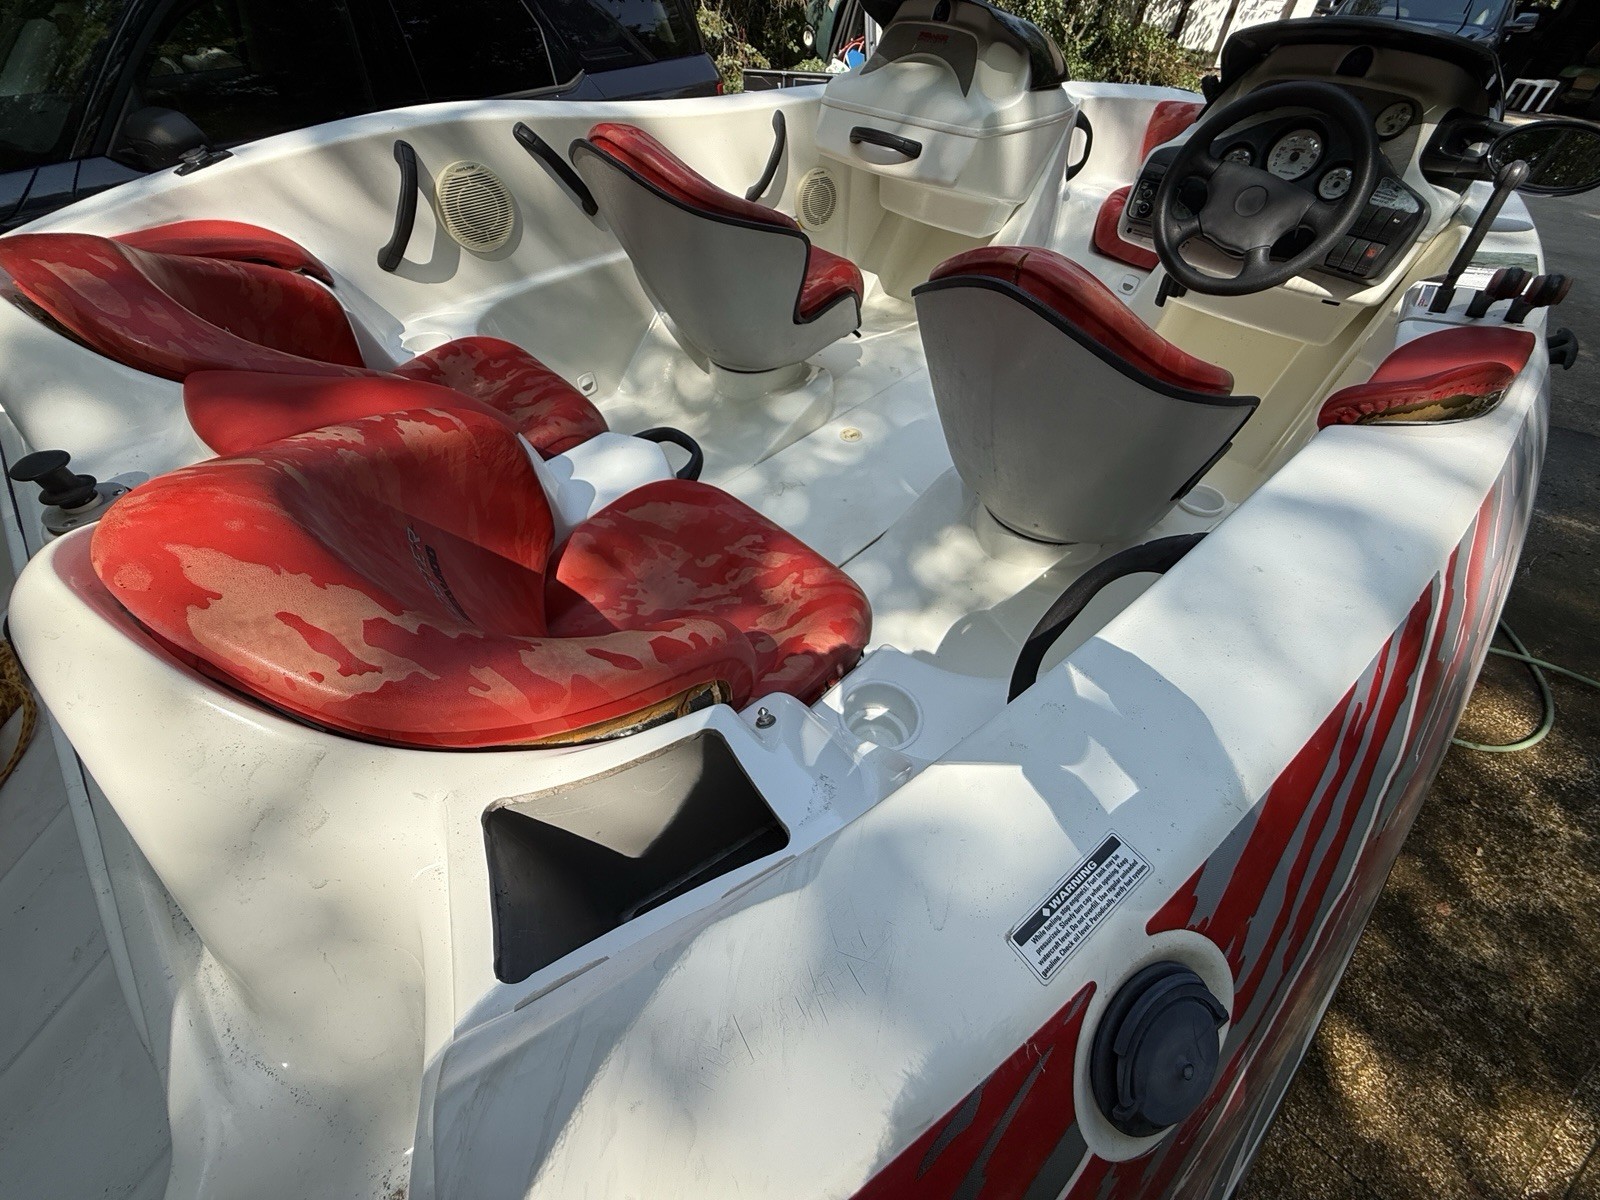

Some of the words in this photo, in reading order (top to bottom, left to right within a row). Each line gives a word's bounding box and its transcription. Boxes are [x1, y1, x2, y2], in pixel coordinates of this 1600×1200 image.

[1031, 931, 1046, 944] While
[1060, 905, 1071, 916] stop
[1086, 875, 1098, 887] Fuel
[1096, 867, 1107, 878] tank
[1105, 859, 1115, 869] may
[1036, 927, 1062, 956] pressurized.
[1059, 913, 1076, 929] Slowly
[1074, 904, 1084, 914] turn
[1083, 896, 1092, 905] cap
[1090, 884, 1103, 897] when
[1116, 858, 1128, 869] Keep
[1038, 941, 1061, 965] watercraft
[1058, 929, 1072, 943] level.
[1069, 923, 1078, 931] Do
[1077, 915, 1085, 925] not
[1097, 892, 1108, 902] Use
[1106, 877, 1121, 893] regular
[1120, 859, 1138, 879] unleaded
[1049, 861, 1097, 909] WARNING
[1059, 941, 1074, 956] Check
[1078, 922, 1091, 936] level.
[1114, 885, 1127, 898] verify
[1123, 876, 1134, 887] fuel
